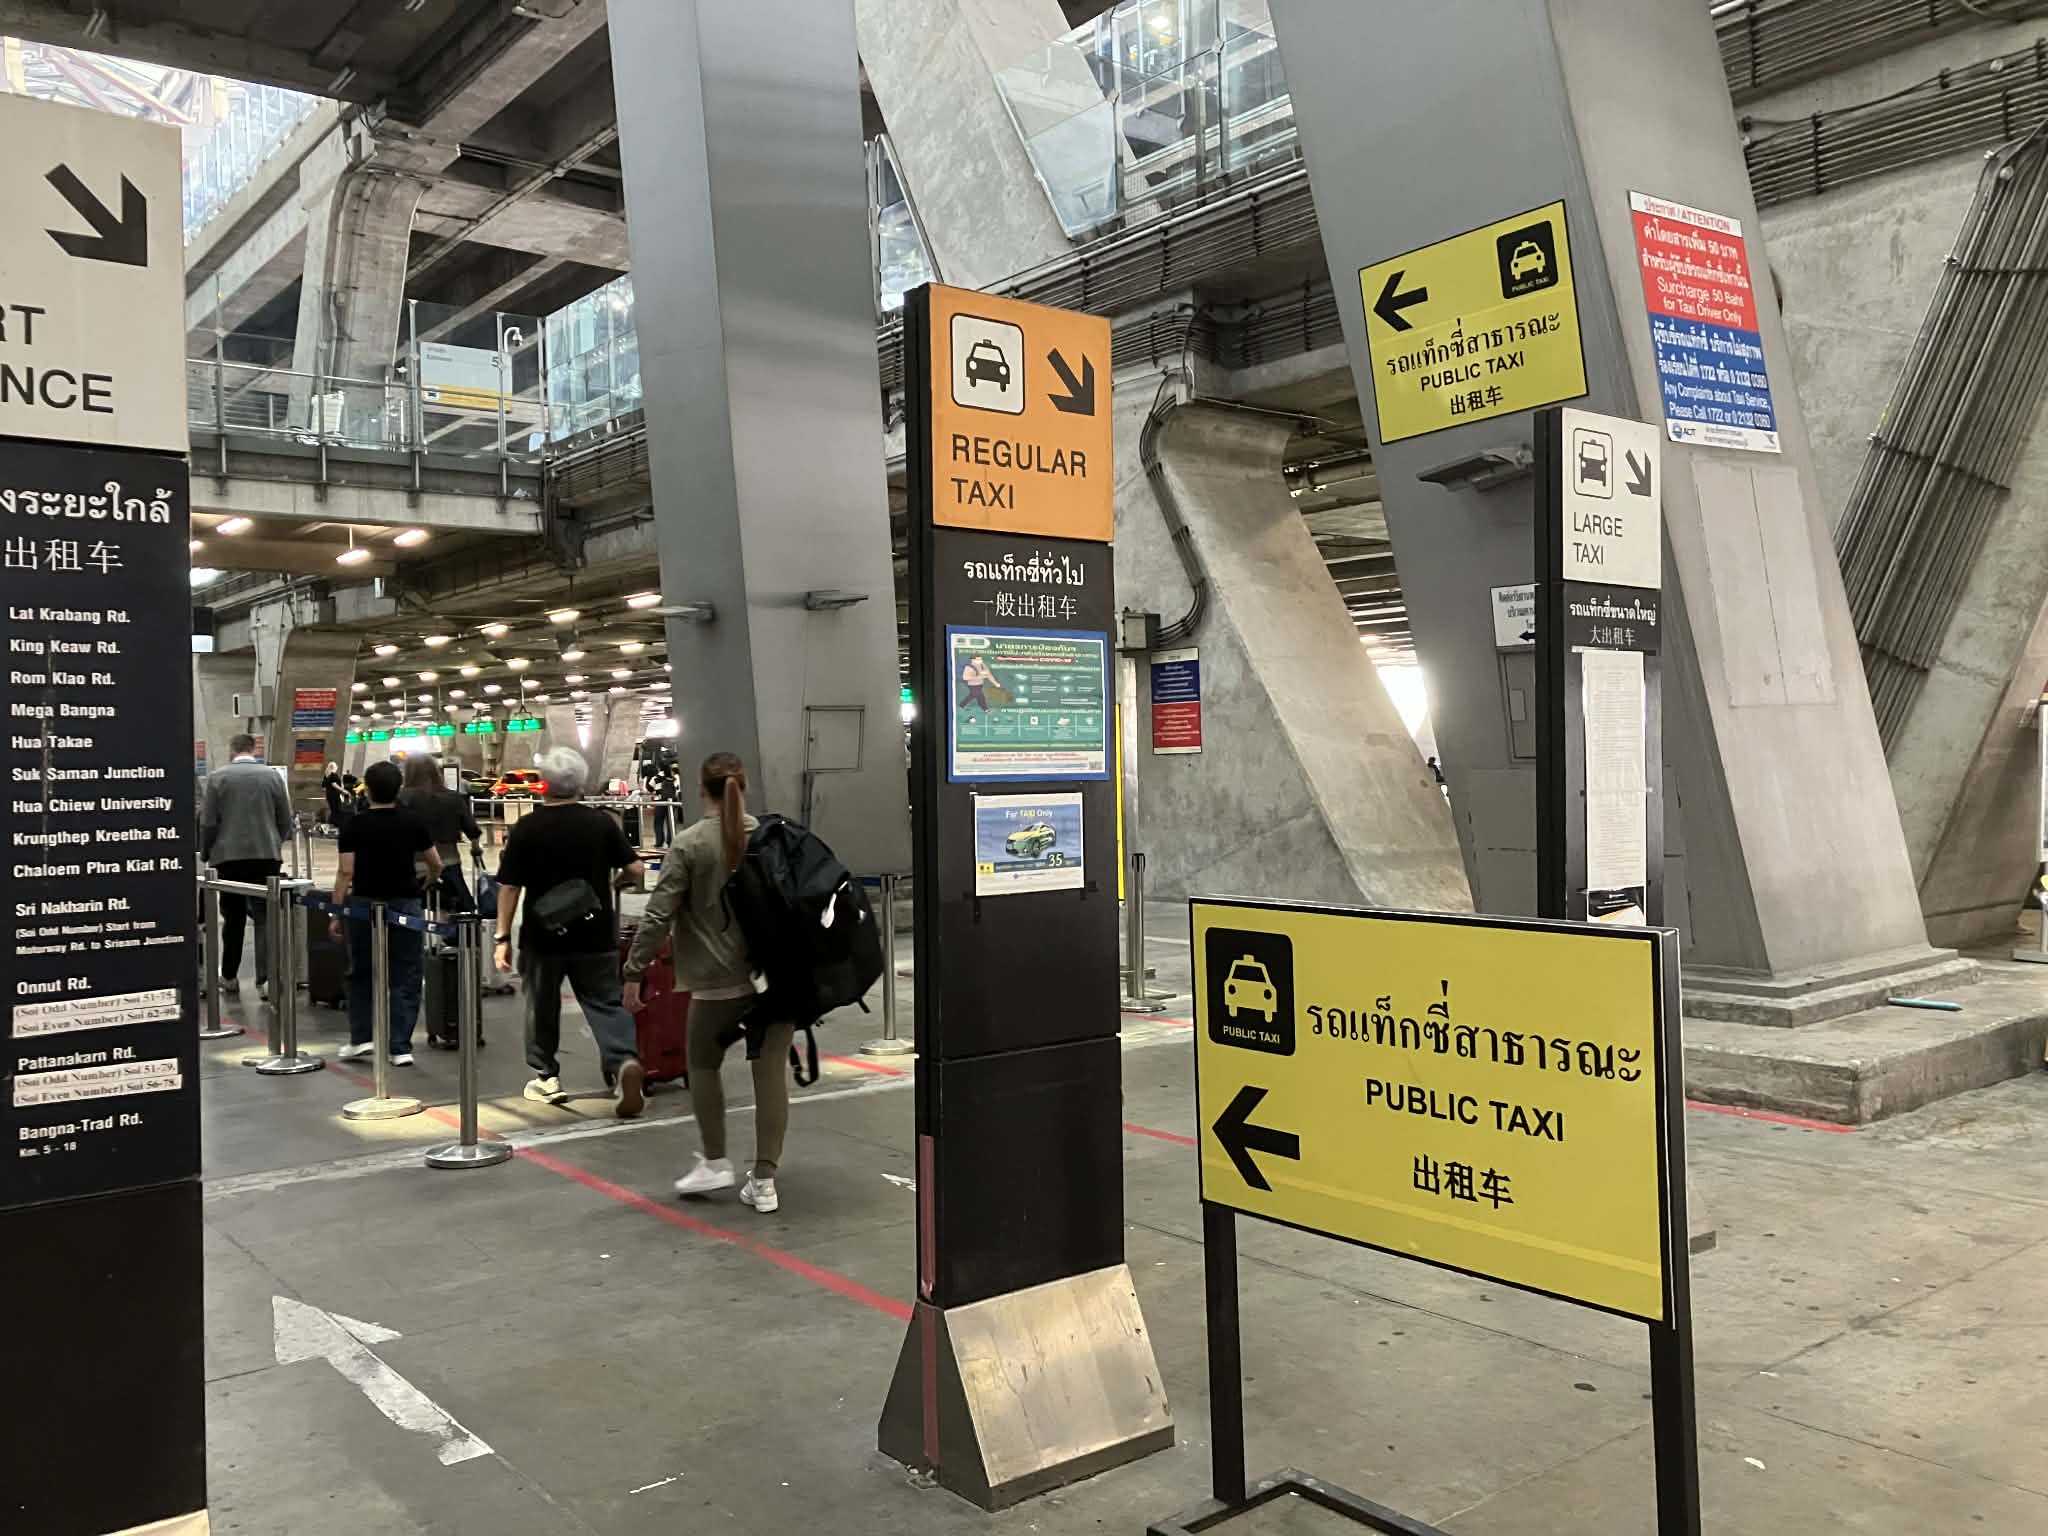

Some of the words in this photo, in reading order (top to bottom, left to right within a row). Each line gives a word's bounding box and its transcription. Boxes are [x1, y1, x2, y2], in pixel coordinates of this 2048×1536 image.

[1681, 210, 1731, 232] ATTENTION
[1657, 276, 1710, 304] Surcharge
[1712, 289, 1724, 302] 50
[1724, 291, 1744, 308] Baht
[1663, 299, 1676, 312] for
[1678, 299, 1696, 315] Taxi
[1697, 303, 1722, 319] Driver
[1723, 309, 1742, 327] Only
[0, 304, 45, 346] T
[1387, 312, 1560, 375] รถแท็กซี่สาธารณะ
[1420, 363, 1481, 392] PUBLIC
[1486, 351, 1525, 375] TAXI
[0, 363, 114, 414] NCE
[1450, 385, 1504, 416] 出租车
[1669, 401, 1693, 417] Please
[952, 434, 1086, 478] REGULAR
[951, 477, 1014, 509] TAXI
[1573, 512, 1624, 538] LARGE
[1572, 542, 1604, 565] TAXI
[963, 550, 1085, 586] รถแท็กซี่ทั่วไป
[9, 606, 34, 620] Lat
[39, 607, 101, 624] Krabang
[107, 610, 131, 623] Rd.
[972, 590, 1078, 621] 一般出租车
[1569, 595, 1657, 626] รถแท็กซี่ขนาดใหญ่
[1589, 624, 1636, 646] 大出租车
[10, 639, 44, 655] King
[50, 640, 92, 653] Keaw
[97, 641, 121, 654] Rd.
[10, 671, 46, 684] Rom
[52, 672, 86, 685] Klao
[91, 672, 116, 685] Rd.
[11, 703, 55, 719] Mega
[60, 703, 116, 719] Bangna
[12, 736, 42, 749] Hua
[47, 735, 94, 748] Takae
[12, 767, 40, 781] Suk
[46, 767, 99, 781] Saman
[103, 766, 165, 780] Junction
[12, 800, 43, 813] Hua
[49, 799, 95, 812] Chiew
[100, 796, 173, 812] University
[1036, 808, 1053, 818] Only
[13, 830, 90, 847] Krungthep
[95, 828, 151, 843] Kreetha
[157, 826, 180, 840] Rd.
[13, 864, 81, 878] Chaloem
[86, 861, 120, 875] Phra
[126, 859, 154, 872] Kiat
[159, 858, 183, 871] Rd.
[1047, 853, 1063, 867] 35
[15, 902, 36, 917] Sri
[41, 899, 103, 915] Nakharin
[108, 896, 131, 911] Rd.
[16, 980, 61, 995] Onnut
[67, 977, 92, 990] Rd.
[1223, 1025, 1257, 1040] PUBLIC
[1259, 1031, 1280, 1044] TAXI
[1306, 979, 1642, 1082] รถแท็กซี่สาธารณะ
[18, 1051, 107, 1071] Pattanakarn
[113, 1046, 136, 1059] Rd.
[1366, 1078, 1479, 1125] PUBLIC
[1489, 1100, 1564, 1142] TAXI
[19, 1116, 113, 1140] Bangna-Trad
[119, 1112, 143, 1126] Rd.
[64, 1141, 77, 1151] 18
[1413, 1153, 1514, 1209] 出租车
